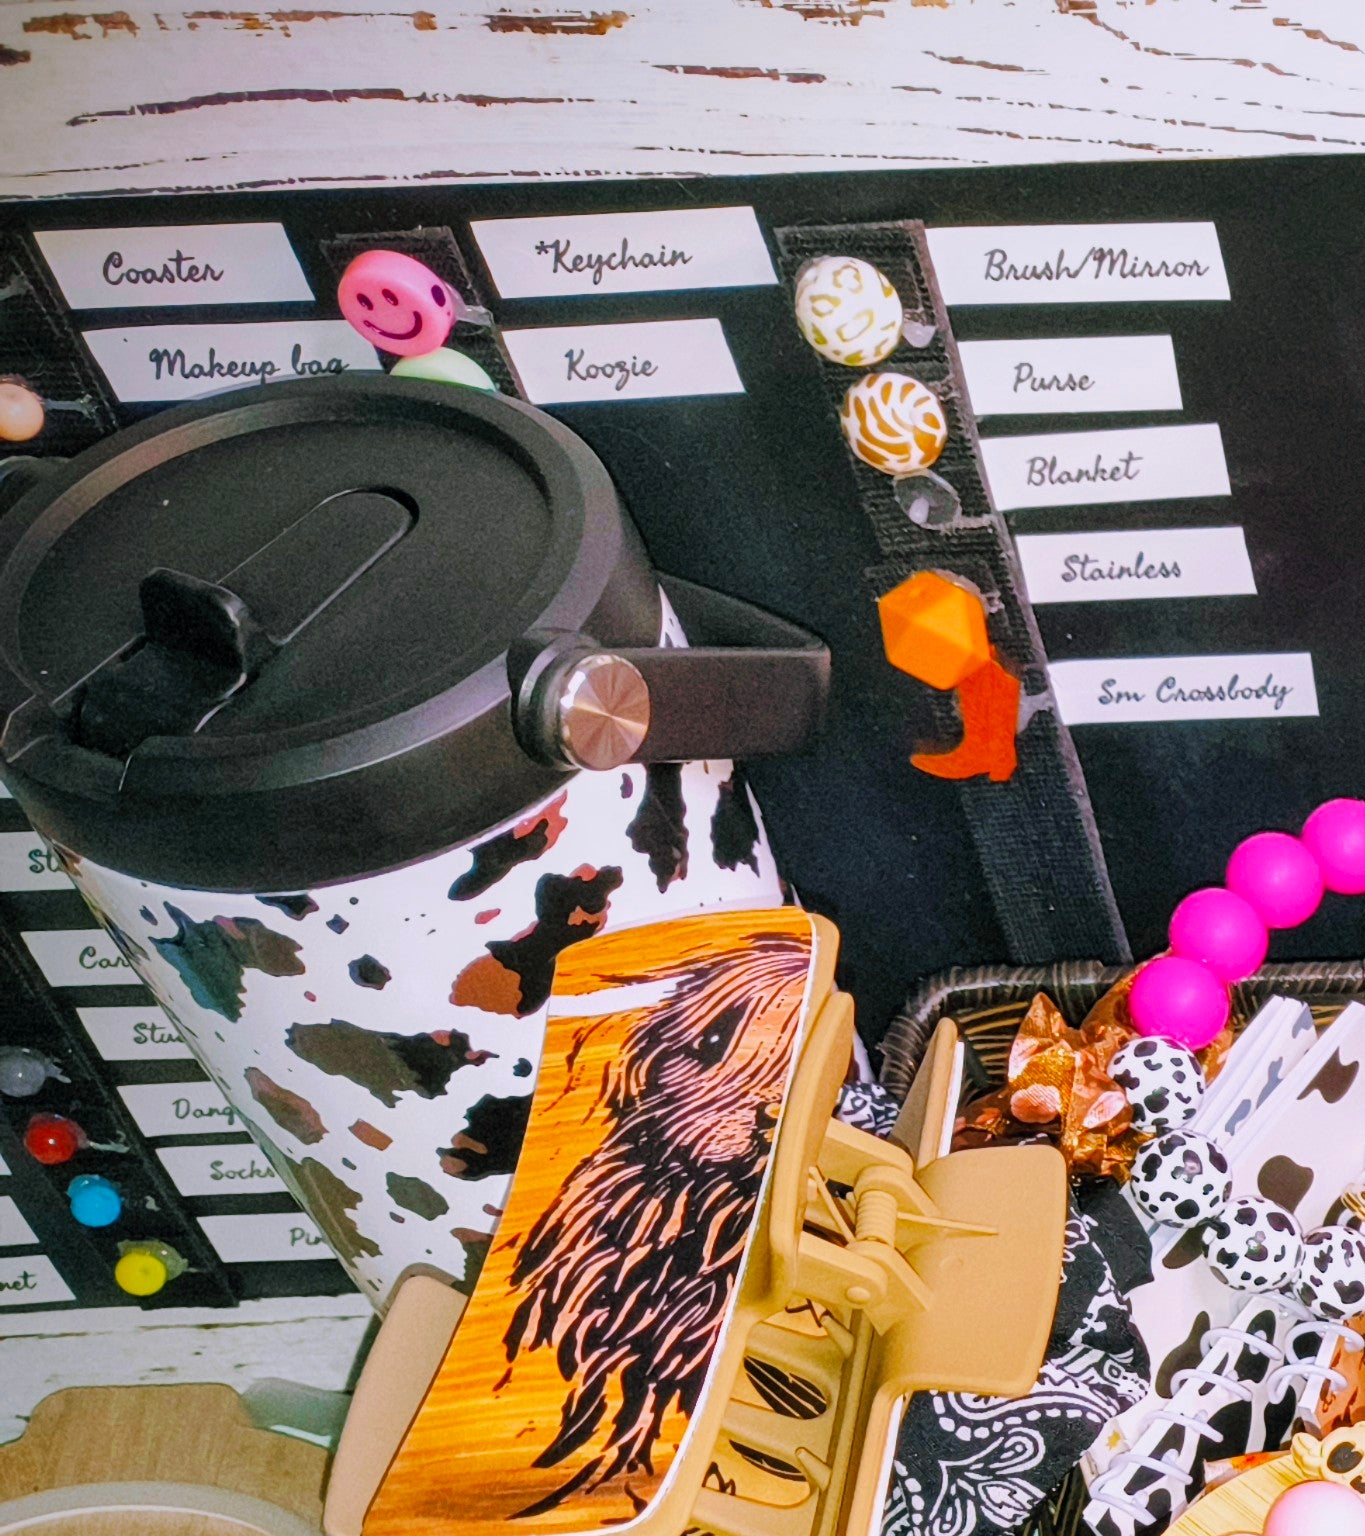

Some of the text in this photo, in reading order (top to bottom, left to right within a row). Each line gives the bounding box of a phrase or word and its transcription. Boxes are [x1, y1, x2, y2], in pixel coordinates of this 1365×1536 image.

[102, 249, 224, 286] Coaster
[983, 247, 1210, 281] Brush/Mirror
[149, 347, 281, 385] Makeup
[565, 348, 659, 389] Koozie
[1012, 362, 1096, 393] Purse
[1025, 450, 1144, 486] Blanket
[1061, 552, 1182, 583] Stainless
[1098, 672, 1294, 712] Sm Crossbody
